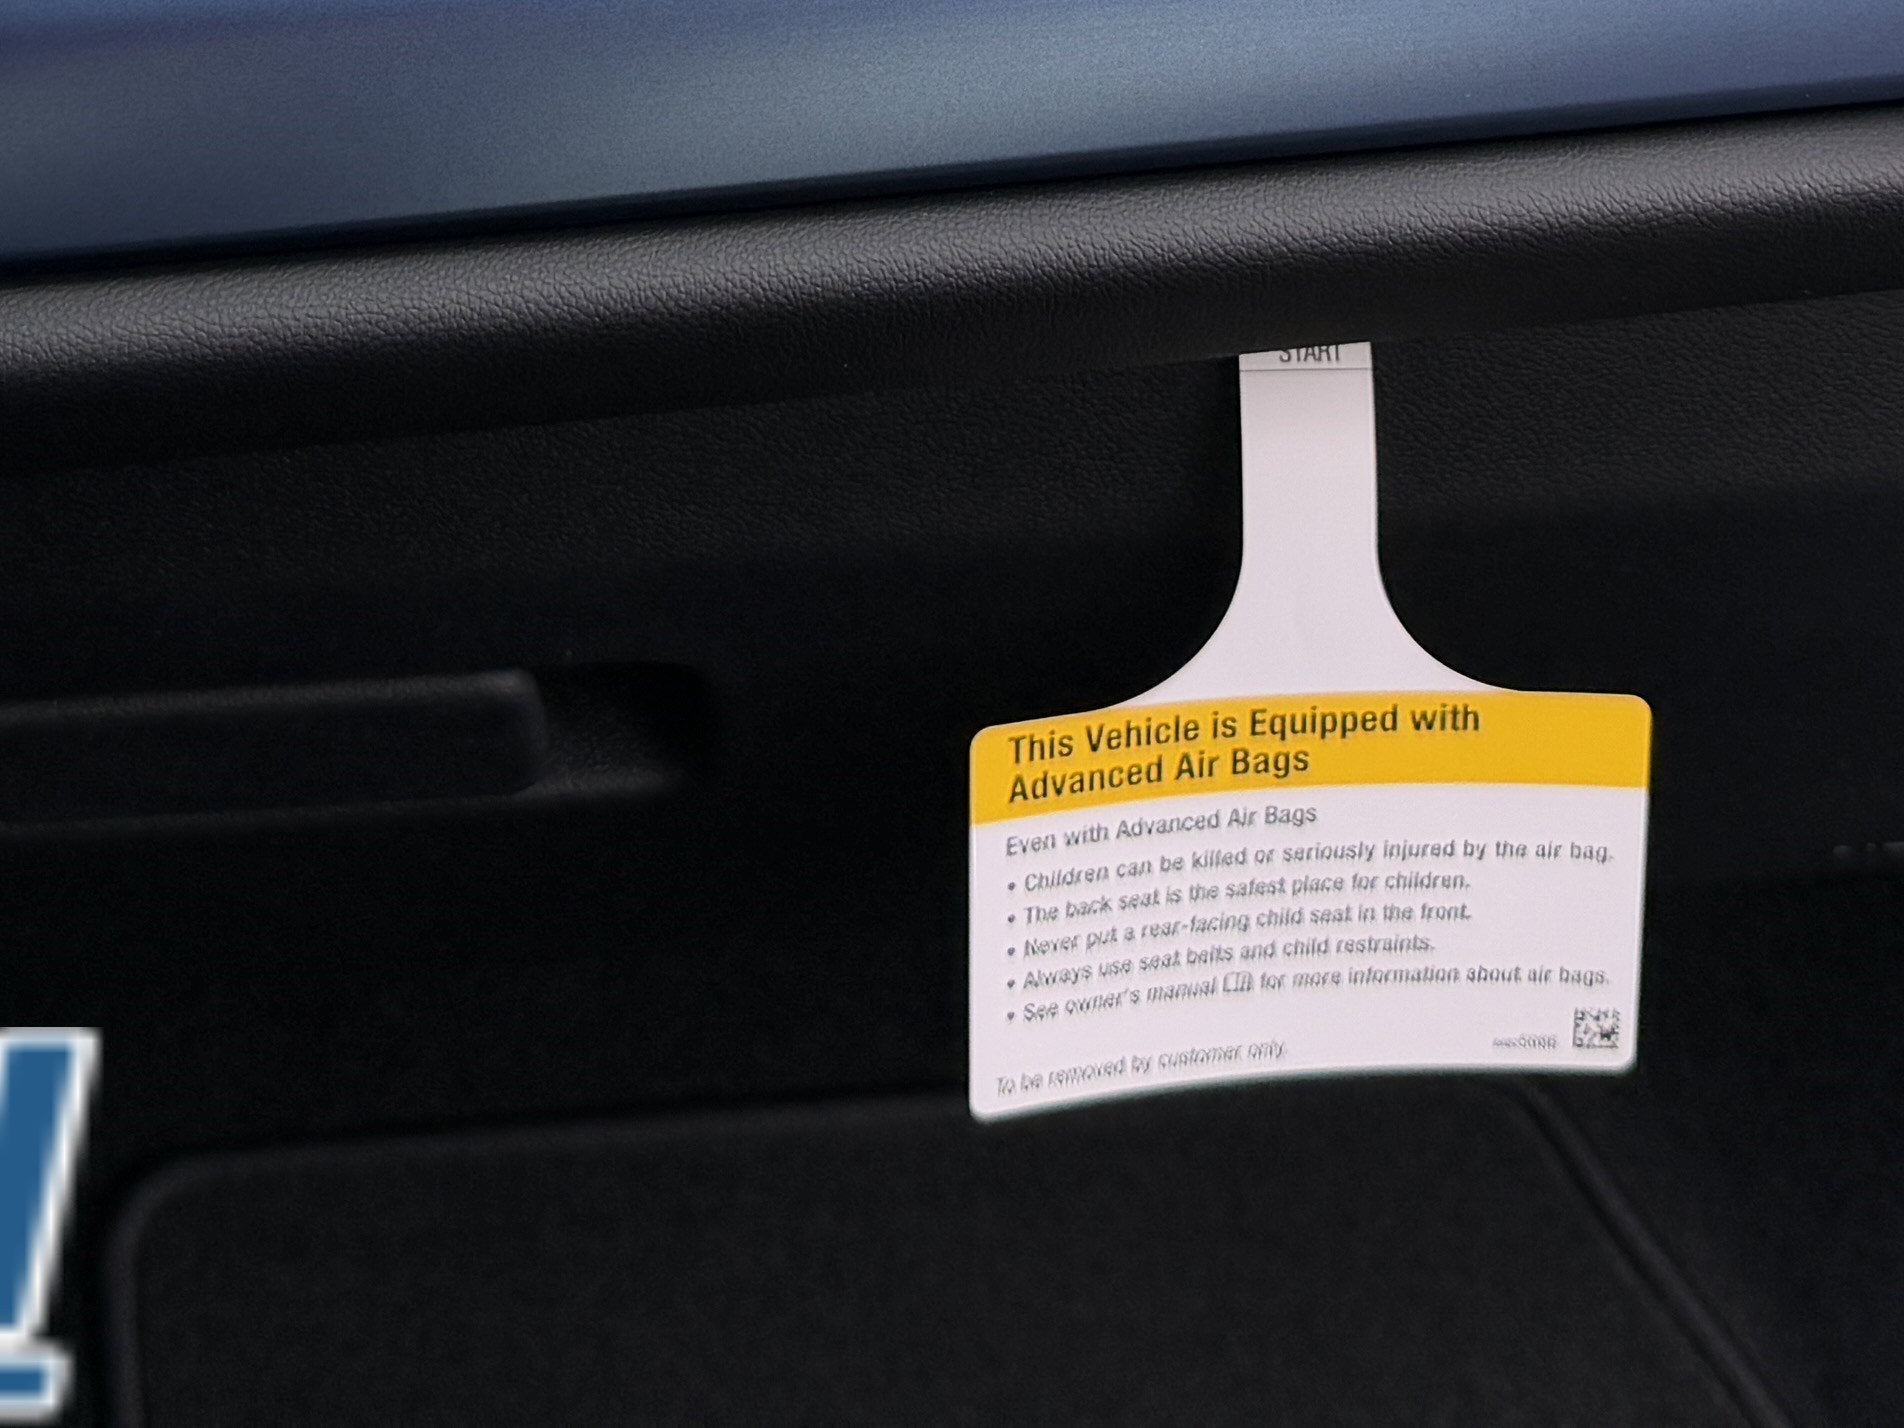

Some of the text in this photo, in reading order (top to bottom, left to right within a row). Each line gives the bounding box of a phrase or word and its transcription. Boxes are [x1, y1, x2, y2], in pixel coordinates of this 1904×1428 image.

[1008, 703, 1481, 764] This Vehicle is Equipped with
[1008, 746, 1310, 803] Advanced Air Bags
[1005, 804, 1318, 856] Even with Advanced Air Bags
[1024, 838, 1614, 892] Children can be killed or seriously injured by the air bag.
[1024, 870, 1472, 925] The back seat is the safest place for children.
[1024, 902, 1473, 958] Never put a rear-facing child seat in the front.
[1023, 933, 1437, 991] Always use seat belts and child restraints.
[1023, 964, 1611, 1022] See owner's manual for more information about air bags.
